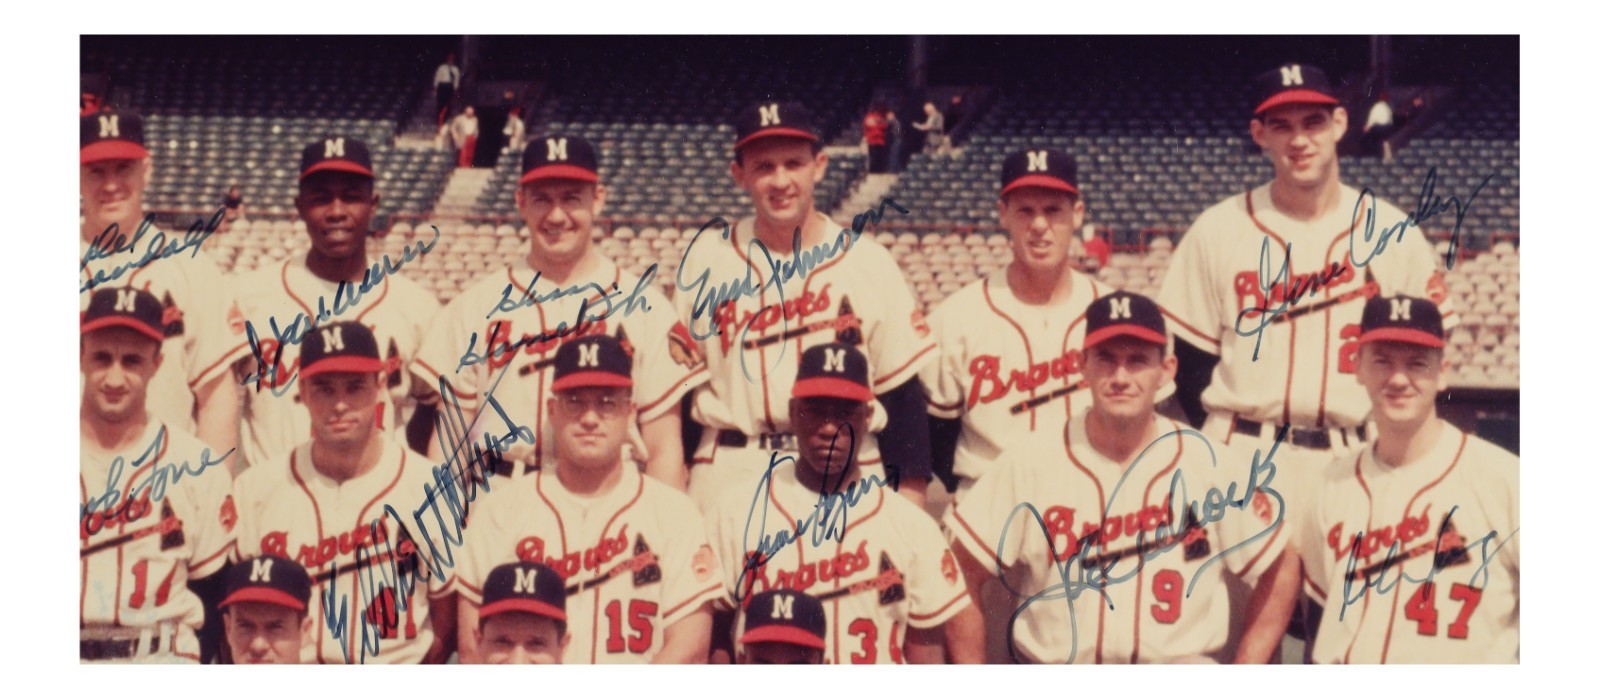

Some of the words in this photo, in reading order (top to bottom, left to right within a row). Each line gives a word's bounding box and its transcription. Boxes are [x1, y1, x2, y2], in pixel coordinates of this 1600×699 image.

[1280, 64, 1304, 86] M
[99, 114, 120, 137] M
[759, 104, 781, 126] M
[324, 137, 345, 158] M
[546, 138, 568, 161] M
[1027, 151, 1049, 171] M
[1350, 166, 1495, 271] Conley
[114, 290, 136, 312] M
[1110, 297, 1132, 319] M
[1390, 299, 1411, 321] M
[322, 327, 345, 353] M
[578, 343, 600, 367] M
[823, 348, 846, 372] M
[967, 348, 1084, 411] Brave
[250, 558, 273, 582] M
[514, 568, 537, 594] M
[771, 595, 794, 619] M
[1150, 568, 1184, 624] 9
[1404, 581, 1483, 640] 47
[605, 598, 659, 654] 15
